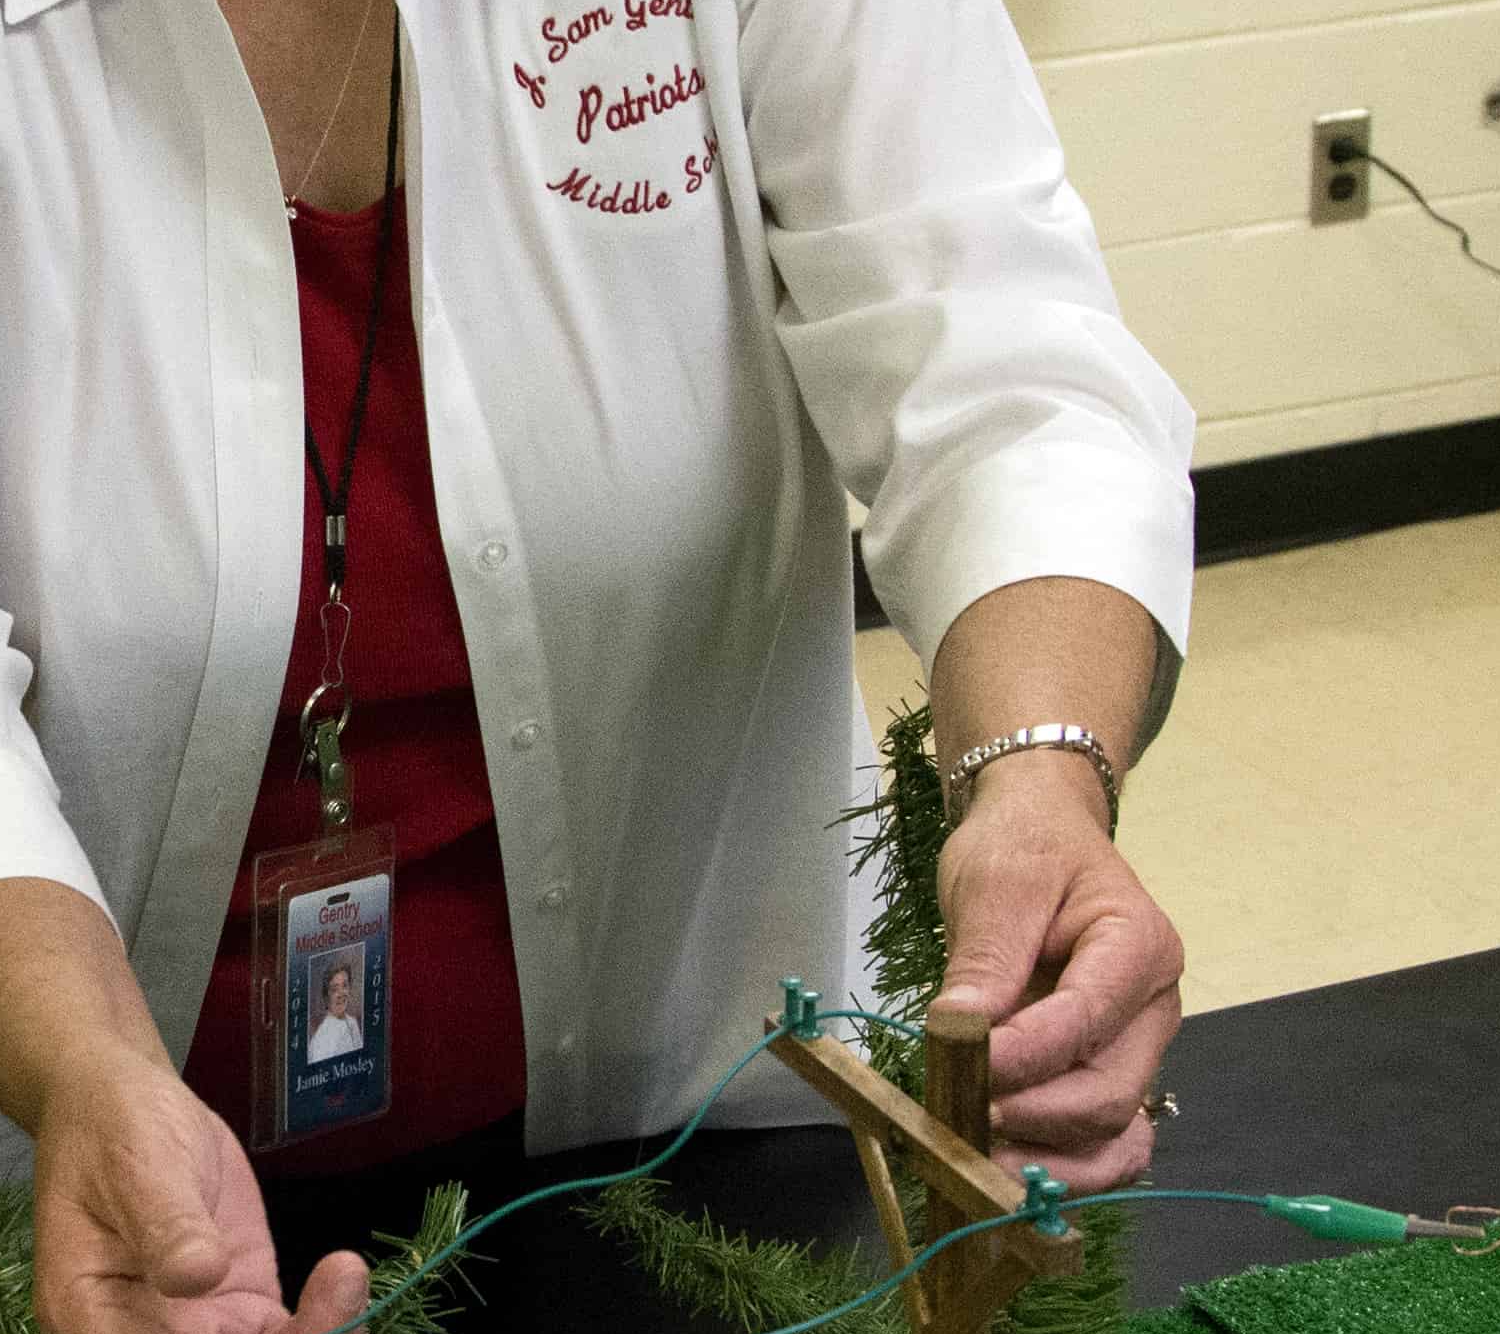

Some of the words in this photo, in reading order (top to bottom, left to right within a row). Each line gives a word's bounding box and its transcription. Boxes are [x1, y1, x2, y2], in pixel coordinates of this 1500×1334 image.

[541, 4, 614, 64] Sam
[576, 63, 706, 145] Patriots
[545, 166, 672, 215] Middle
[295, 930, 336, 953] Middle
[339, 914, 383, 941] School
[318, 902, 361, 925] Gentry
